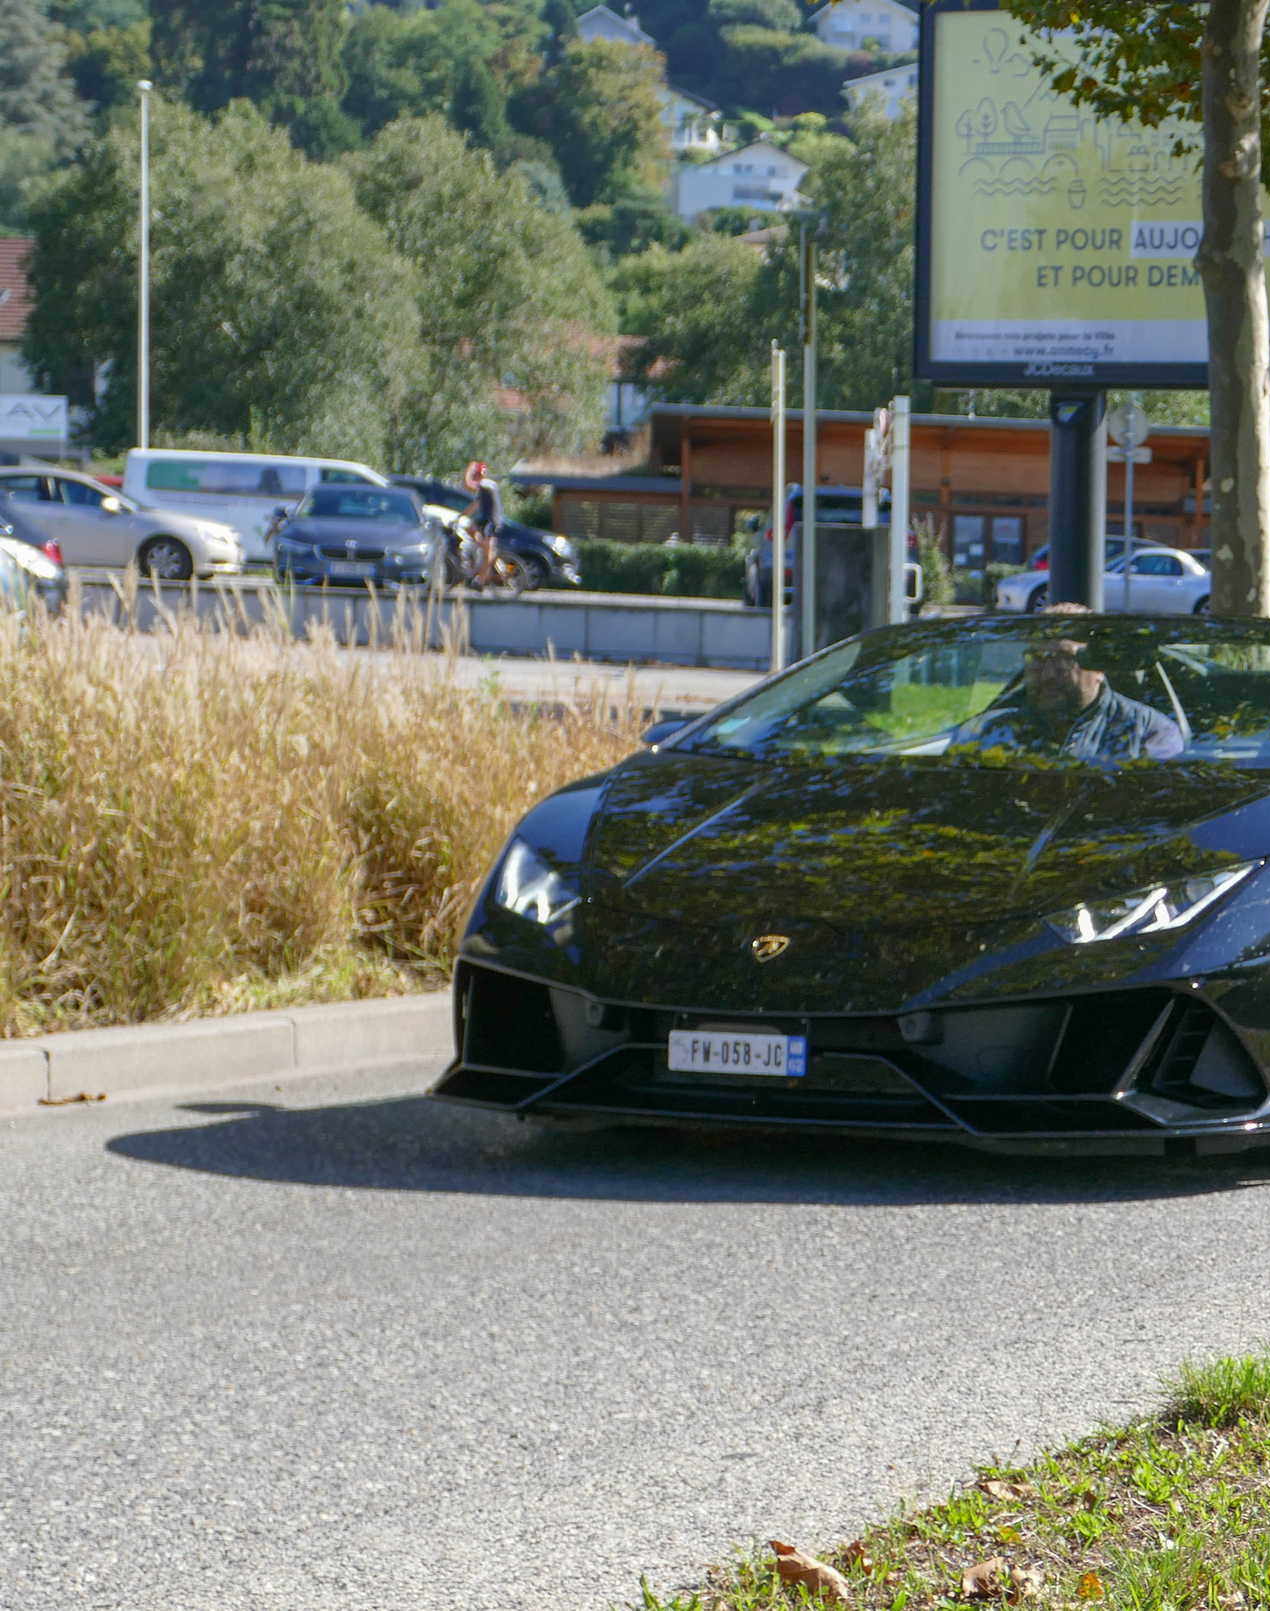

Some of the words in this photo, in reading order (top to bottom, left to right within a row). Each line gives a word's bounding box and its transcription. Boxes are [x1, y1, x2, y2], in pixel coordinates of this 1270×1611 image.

[981, 228, 1047, 251] C'EST
[1056, 228, 1123, 251] POUR
[1037, 265, 1064, 287] ET
[1072, 265, 1138, 287] POUR
[1148, 264, 1200, 287] DEM
[1013, 343, 1114, 360] www.annecy.fr
[1023, 362, 1095, 377] JCDecaux
[691, 1040, 782, 1067] FW-058-JC
